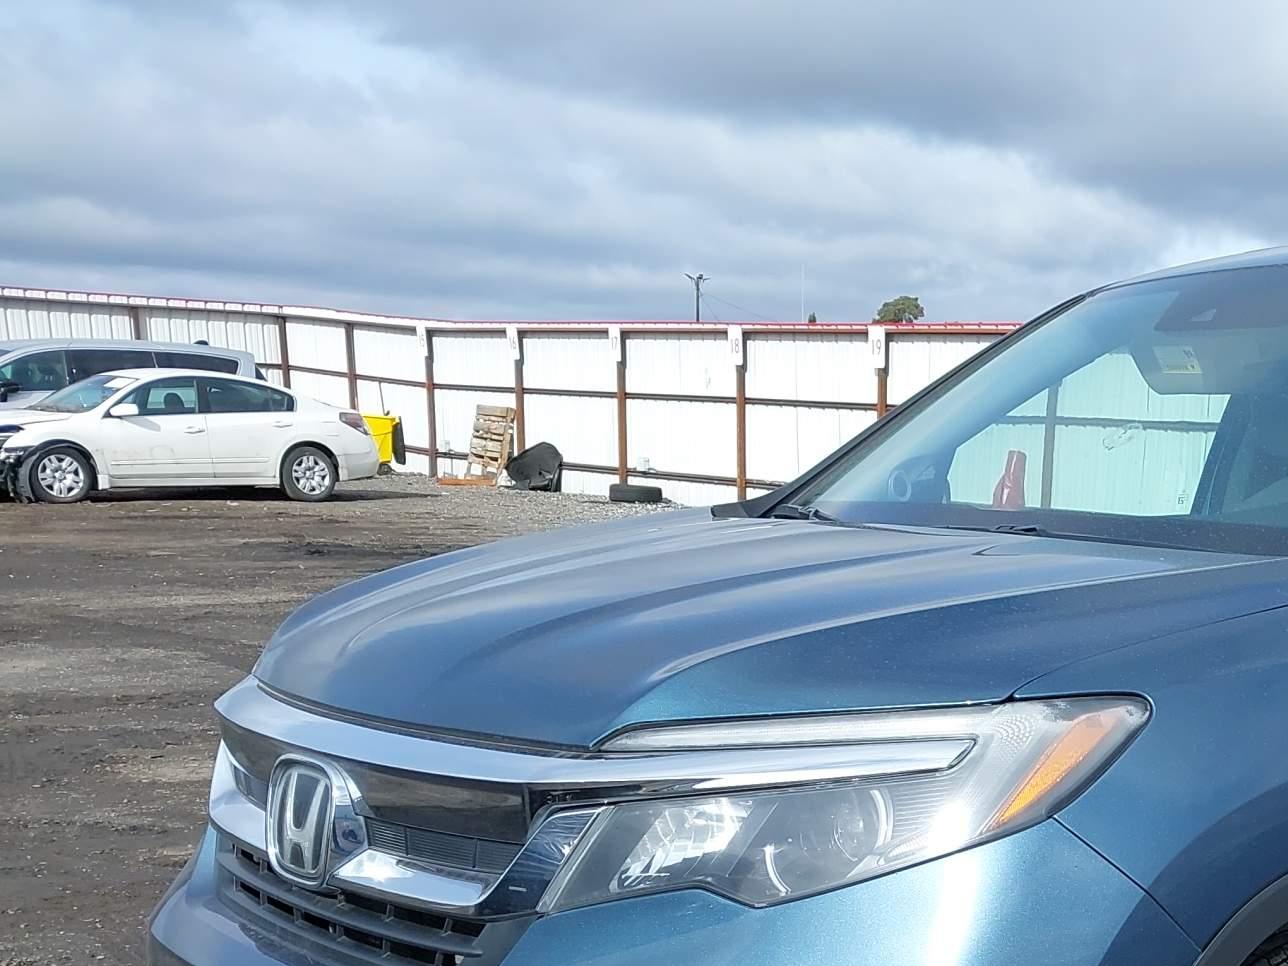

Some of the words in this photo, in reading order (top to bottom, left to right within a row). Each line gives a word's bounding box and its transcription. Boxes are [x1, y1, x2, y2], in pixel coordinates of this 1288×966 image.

[610, 336, 619, 350] 17
[730, 338, 740, 354] 18
[871, 338, 882, 355] 19
